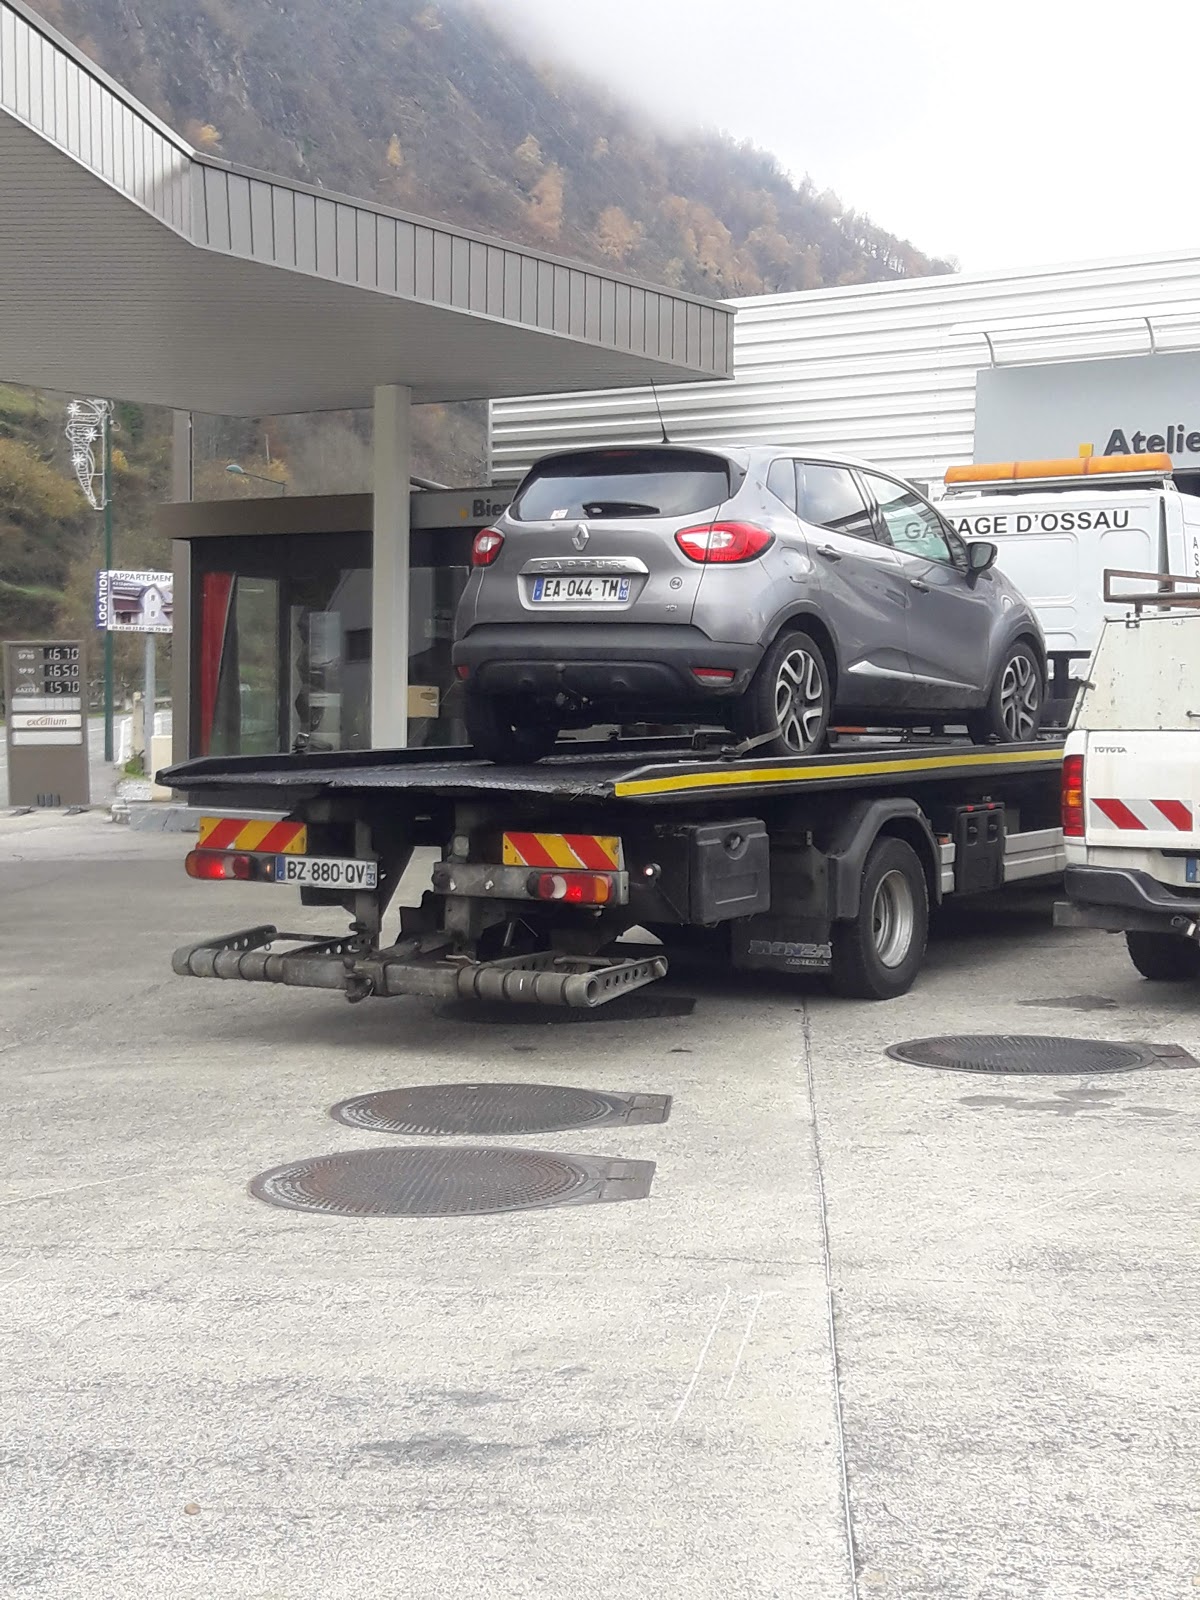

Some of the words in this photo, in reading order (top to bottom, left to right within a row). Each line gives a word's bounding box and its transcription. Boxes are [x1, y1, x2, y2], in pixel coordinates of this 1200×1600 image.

[1103, 424, 1200, 457] Atelie
[1016, 510, 1130, 533] D'OSSAU
[540, 560, 626, 570] CAPTUR
[98, 571, 108, 627] LOCATION
[26, 716, 68, 726] excellium
[287, 861, 366, 884] BZ-880-QV
